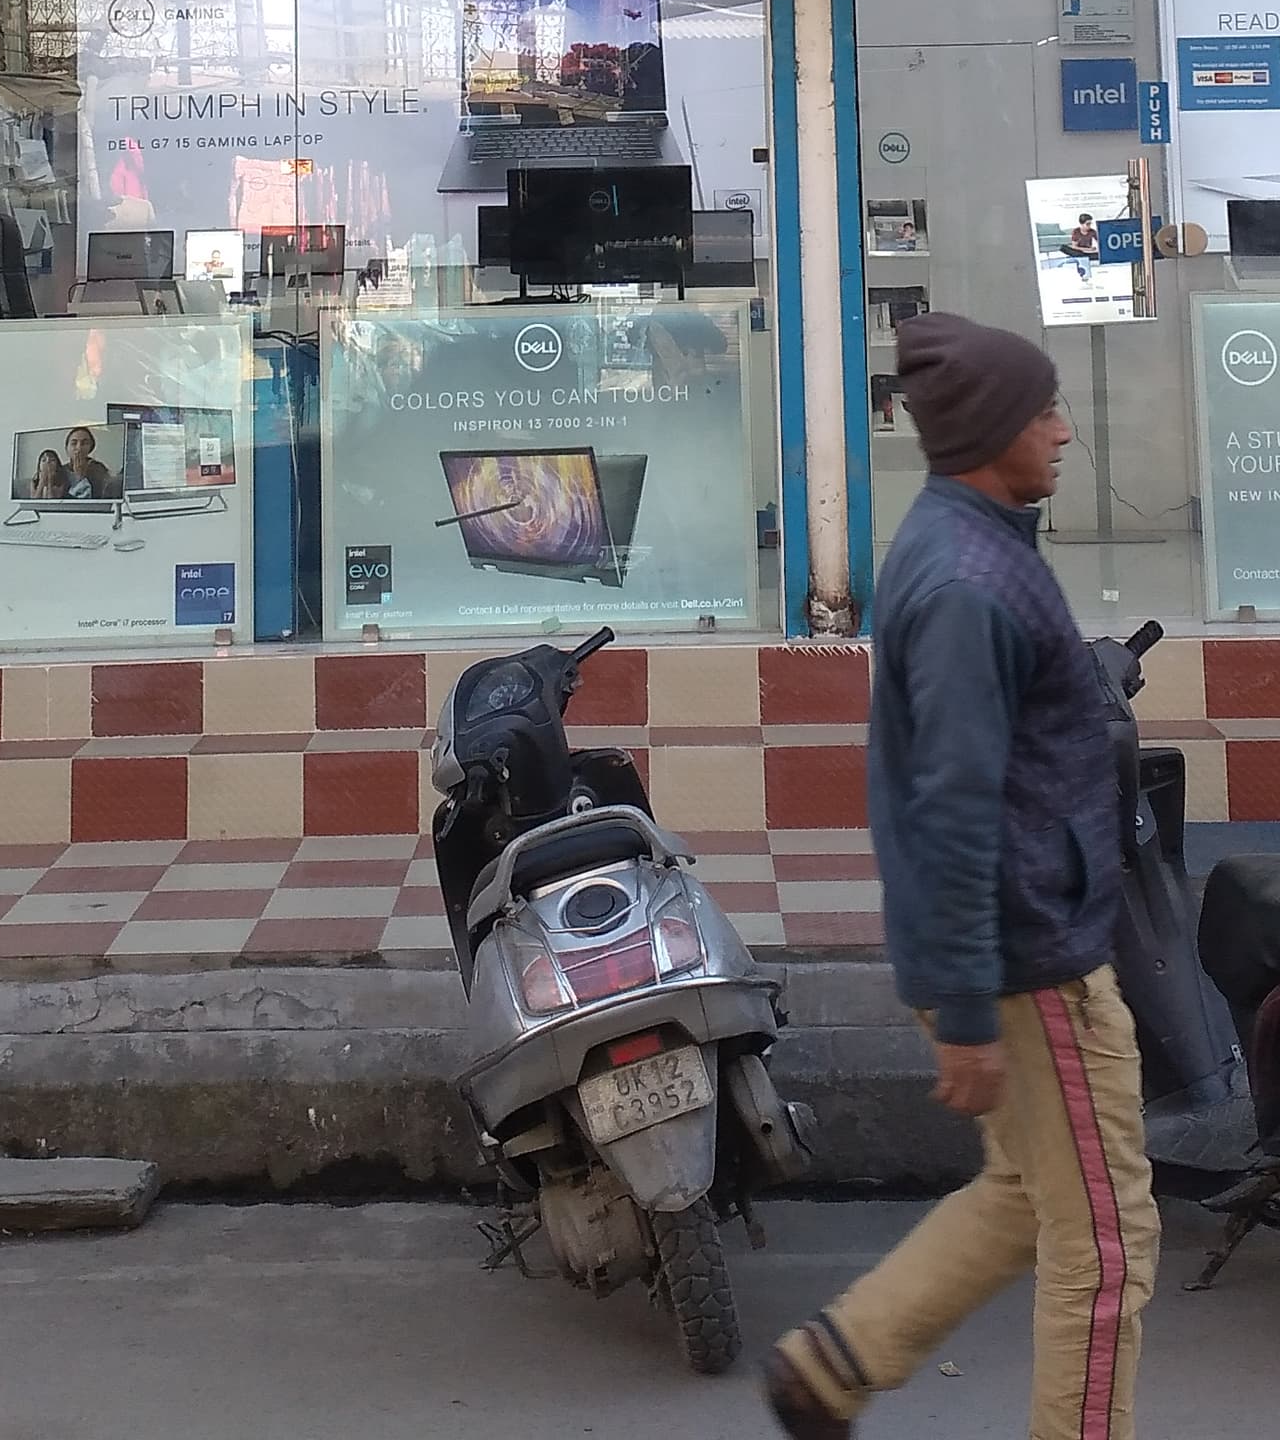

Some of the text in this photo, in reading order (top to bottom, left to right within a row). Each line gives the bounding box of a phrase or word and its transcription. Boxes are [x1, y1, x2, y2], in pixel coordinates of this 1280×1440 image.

[164, 8, 225, 21] GAMING
[1073, 82, 1126, 106] intel
[108, 93, 260, 121] TRIUMPH
[275, 93, 306, 117] IN
[1150, 85, 1163, 140] PUSH
[108, 134, 324, 151] DELL G7 15 GAMING LAPTOP
[728, 195, 749, 205] intel
[1107, 232, 1143, 250] OPE
[521, 340, 557, 355] DELL
[1229, 350, 1272, 365] DELL
[391, 385, 690, 411] COLORS YOU CAN TOUCH
[453, 415, 628, 433] INSPIRON 13 7000 2-IN-1
[1226, 431, 1241, 449] A
[1228, 490, 1263, 502] NEW
[181, 568, 203, 579] intel
[349, 563, 389, 578] evo
[1233, 567, 1280, 581] Contact
[458, 604, 493, 616] Contact
[502, 603, 519, 614] Dell
[520, 603, 581, 616] representative
[583, 601, 596, 612] for
[131, 618, 168, 629] processor
[223, 612, 233, 621] i7
